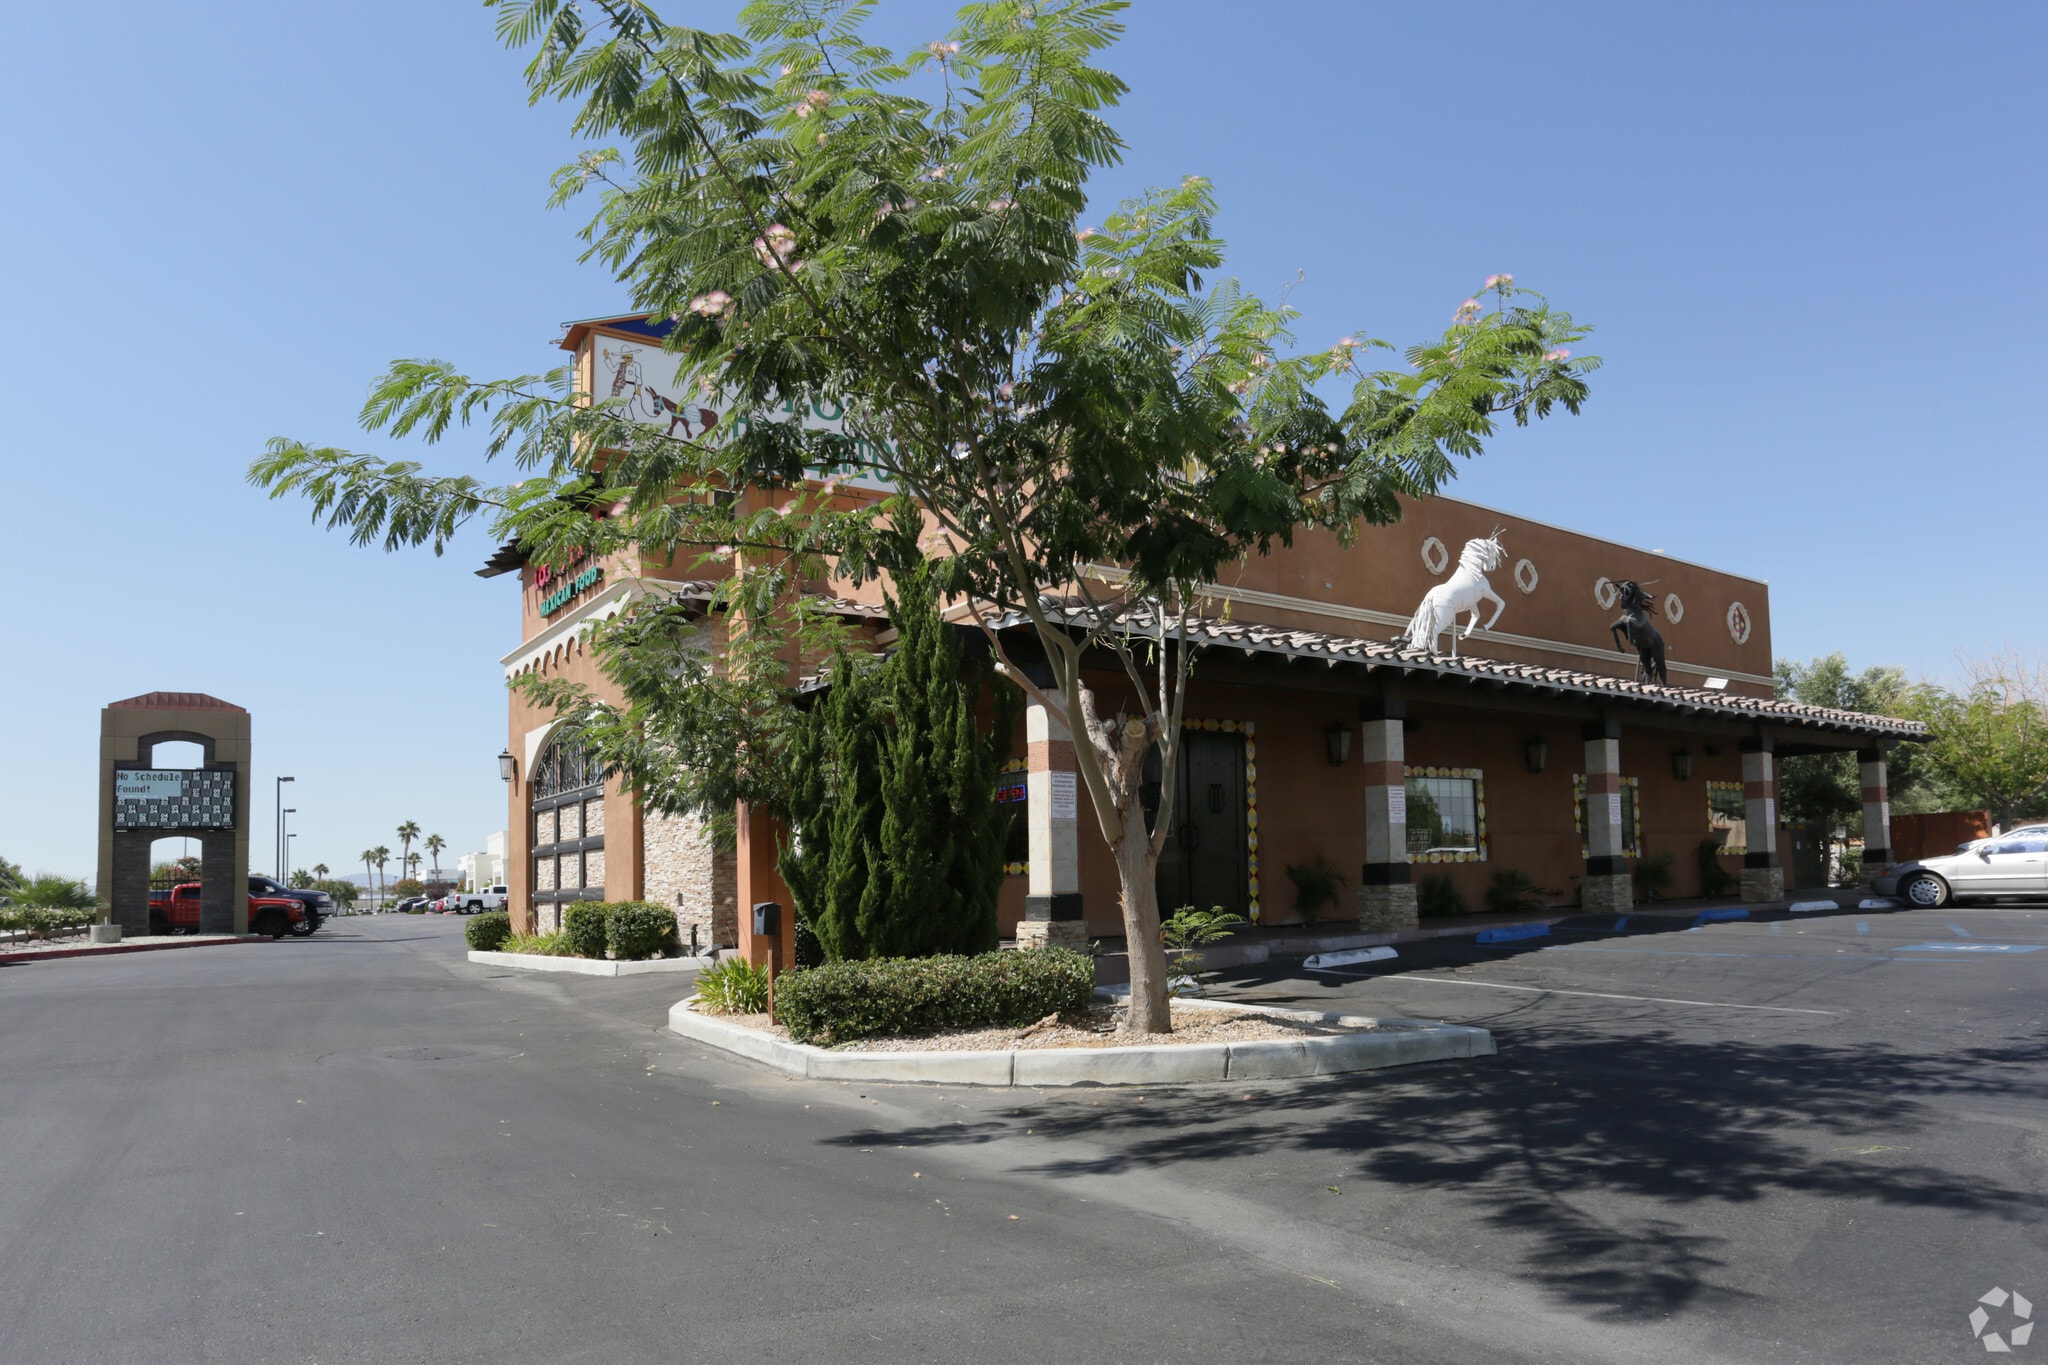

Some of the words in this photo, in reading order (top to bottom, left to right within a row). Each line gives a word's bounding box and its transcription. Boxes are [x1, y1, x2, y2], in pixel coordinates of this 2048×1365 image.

[541, 583, 572, 617] MEXICAN
[575, 565, 598, 594] FOOD
[117, 772, 129, 781] No
[135, 772, 180, 781] Schedule
[117, 785, 151, 793] Found!
